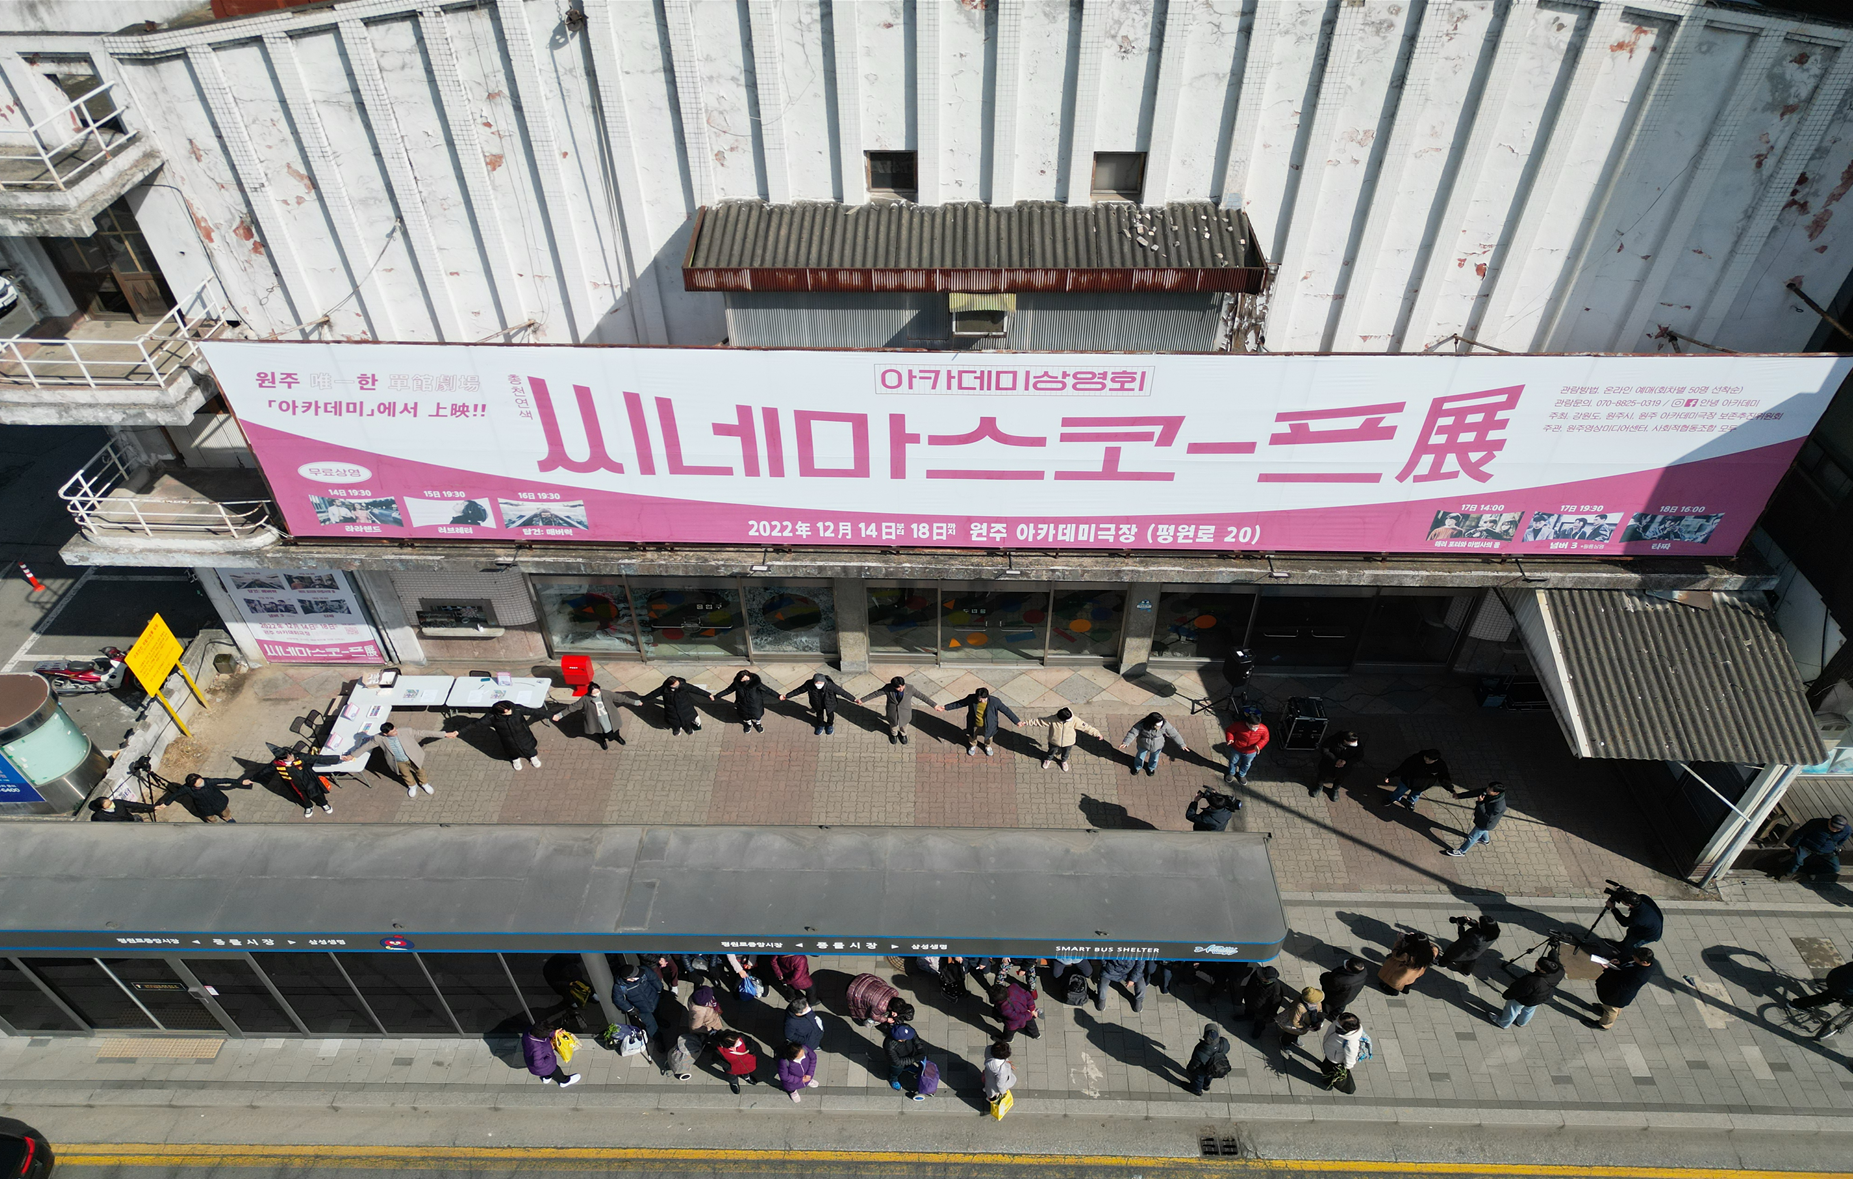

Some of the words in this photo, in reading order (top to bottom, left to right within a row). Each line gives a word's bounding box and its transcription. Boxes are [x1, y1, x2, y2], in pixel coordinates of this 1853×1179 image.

[255, 372, 301, 389] 원주
[310, 373, 378, 390] 唯一한
[388, 374, 481, 392] 單館劇場
[880, 369, 1147, 392] 아카데미상영회
[1603, 386, 1634, 394] 온라인
[1635, 386, 1686, 394] 예매(회차별
[1688, 386, 1710, 394] 50명
[1712, 386, 1744, 394] 선착순)
[508, 374, 533, 420] 총천연색
[1700, 399, 1720, 407] 안녕
[268, 400, 419, 418] 「아카데미」에서
[428, 402, 487, 418] 上映!!
[1639, 412, 1658, 420] 원주
[1660, 412, 1716, 420] 아카데미극장
[1718, 412, 1784, 420] 보존추진위원회
[1652, 424, 1716, 432] 사회적협동조합
[1718, 424, 1738, 432] 모두
[309, 468, 361, 478] 무료상영
[546, 528, 573, 536] 매버릭
[748, 520, 812, 538] 2022年
[816, 521, 852, 539] 12月
[970, 523, 1007, 541] 원주
[1016, 523, 1138, 542] 아카데미극장
[1147, 524, 1216, 544] (평원로
[1224, 524, 1261, 545] 20)
[595, 701, 608, 716] R
